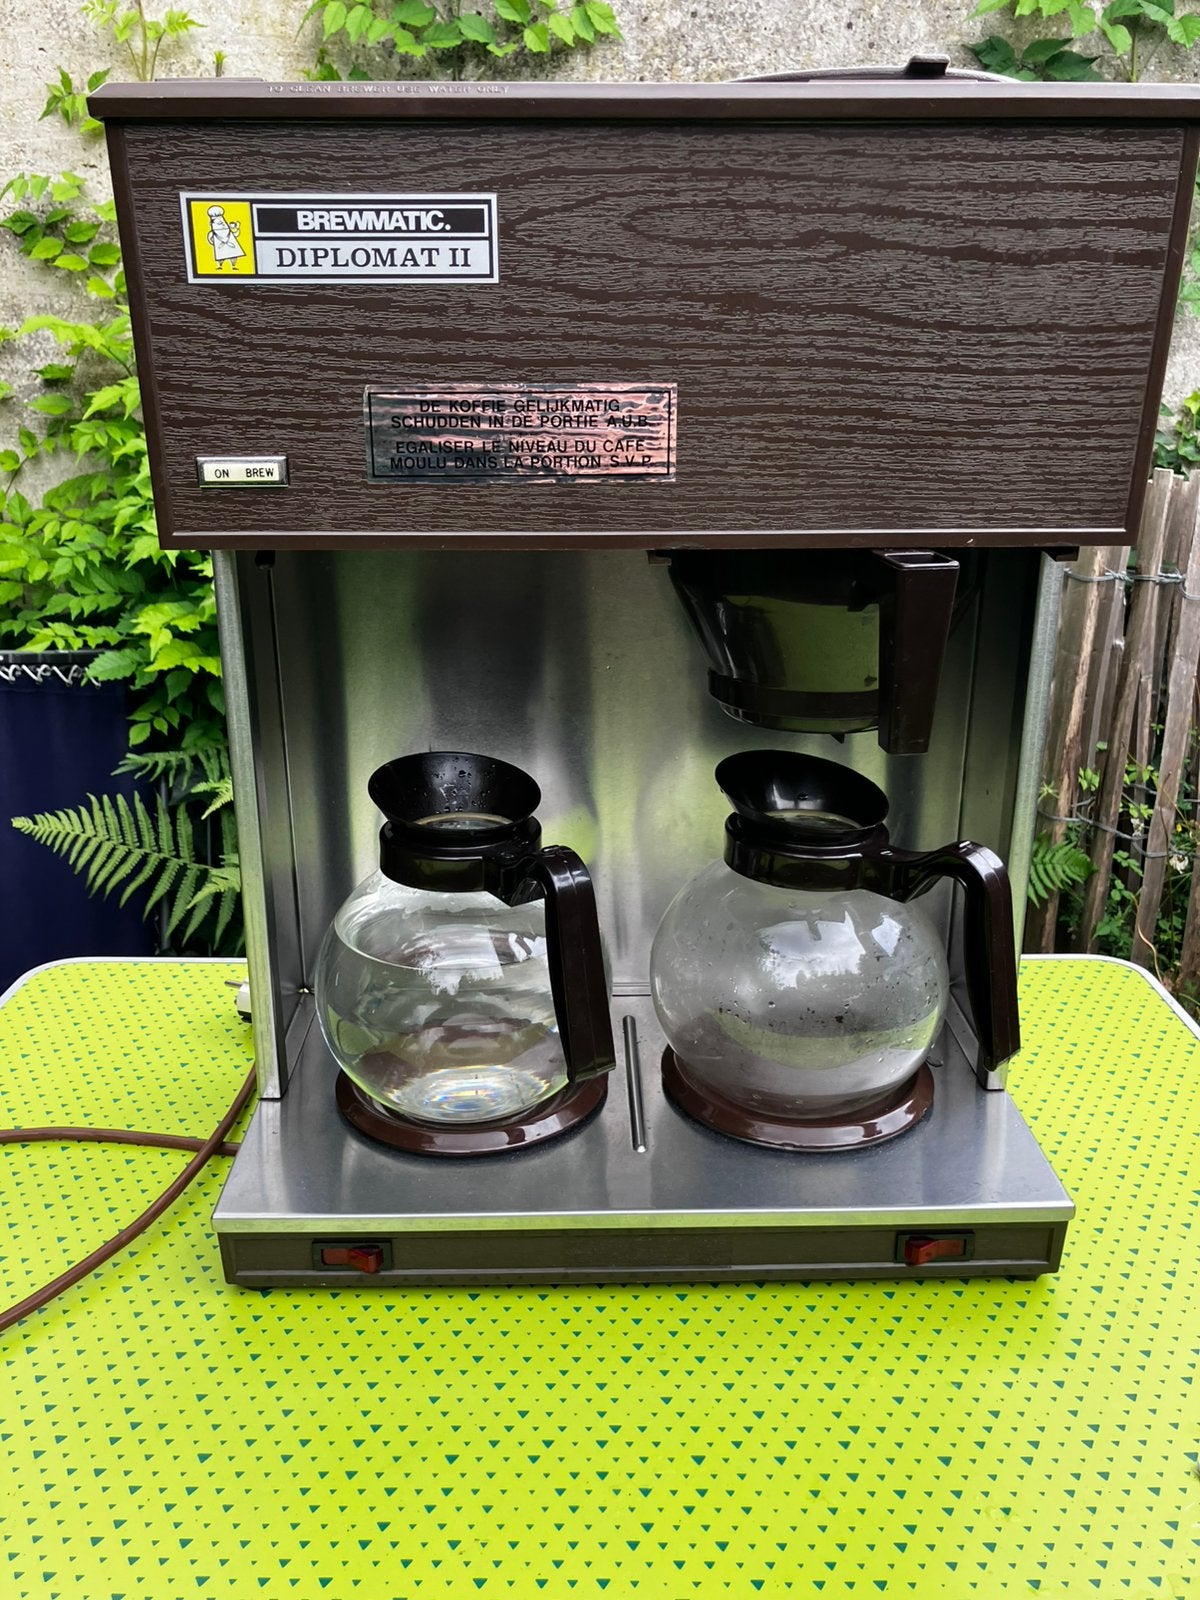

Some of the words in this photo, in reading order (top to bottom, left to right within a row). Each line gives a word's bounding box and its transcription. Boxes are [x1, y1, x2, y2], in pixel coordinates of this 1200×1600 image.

[267, 85, 283, 94] TO
[290, 85, 331, 94] CLEAN
[338, 85, 391, 94] BREWER
[396, 85, 420, 94] USE
[428, 85, 471, 94] WATER
[477, 85, 510, 94] ONLY
[276, 247, 440, 268] DIPLOMAT
[449, 247, 471, 268] II
[419, 400, 441, 413] DE
[449, 400, 505, 413] KOFFIE
[513, 399, 620, 412] GELIJKMATIG
[391, 416, 481, 429] SCHUDDEN
[488, 416, 504, 429] IN
[511, 416, 531, 428] DE
[540, 415, 598, 428] PORTIE
[396, 441, 474, 454] EGALISER
[483, 441, 500, 454] LE
[508, 440, 567, 453] NIVEAU
[574, 440, 596, 453] DU
[390, 456, 447, 469] MOULU
[454, 456, 498, 469] DANS
[504, 456, 523, 469] LA
[531, 456, 600, 469] PORTION
[214, 469, 229, 478] ON
[245, 468, 274, 478] BREW
